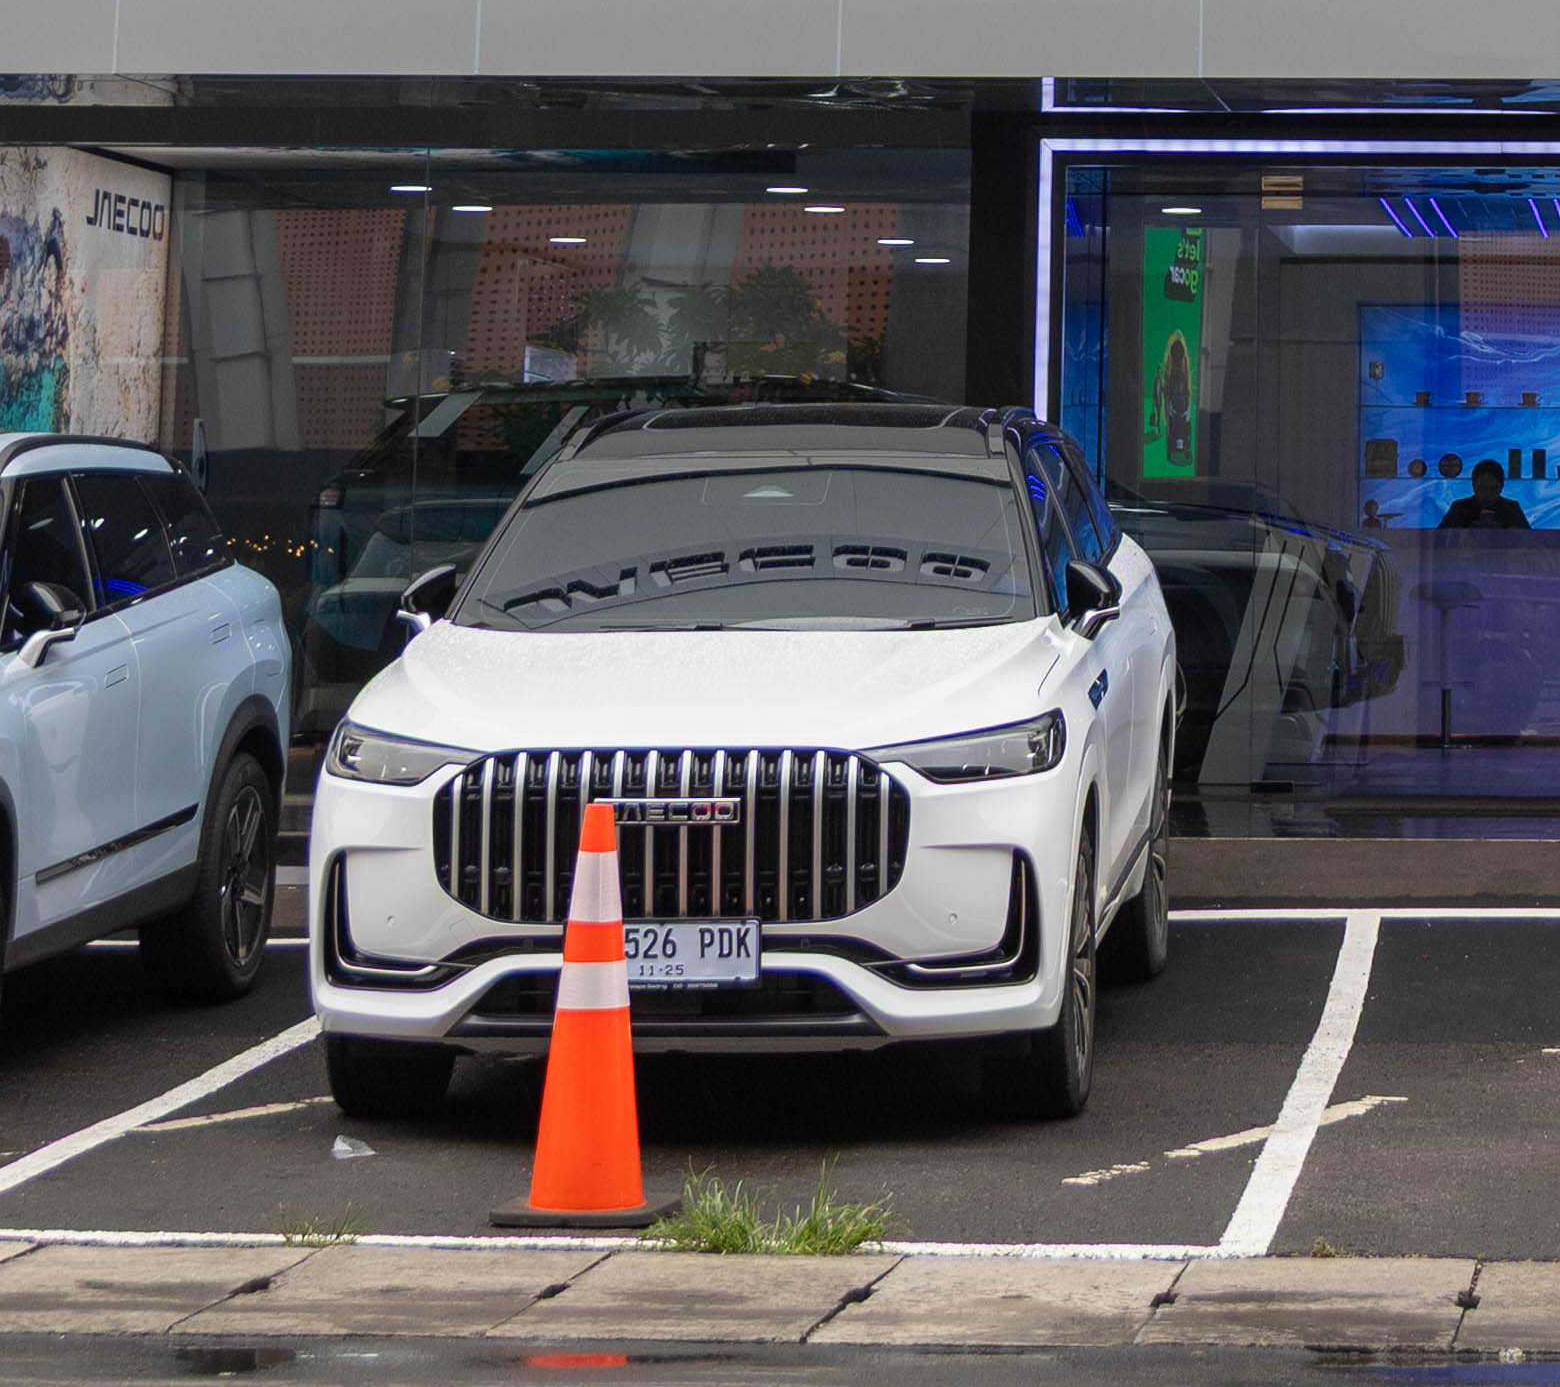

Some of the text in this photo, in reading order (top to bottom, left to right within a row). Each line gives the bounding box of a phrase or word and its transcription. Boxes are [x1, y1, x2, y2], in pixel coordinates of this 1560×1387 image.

[86, 188, 165, 241] JAECOO
[614, 801, 735, 821] AECOO
[699, 927, 752, 959] PDK
